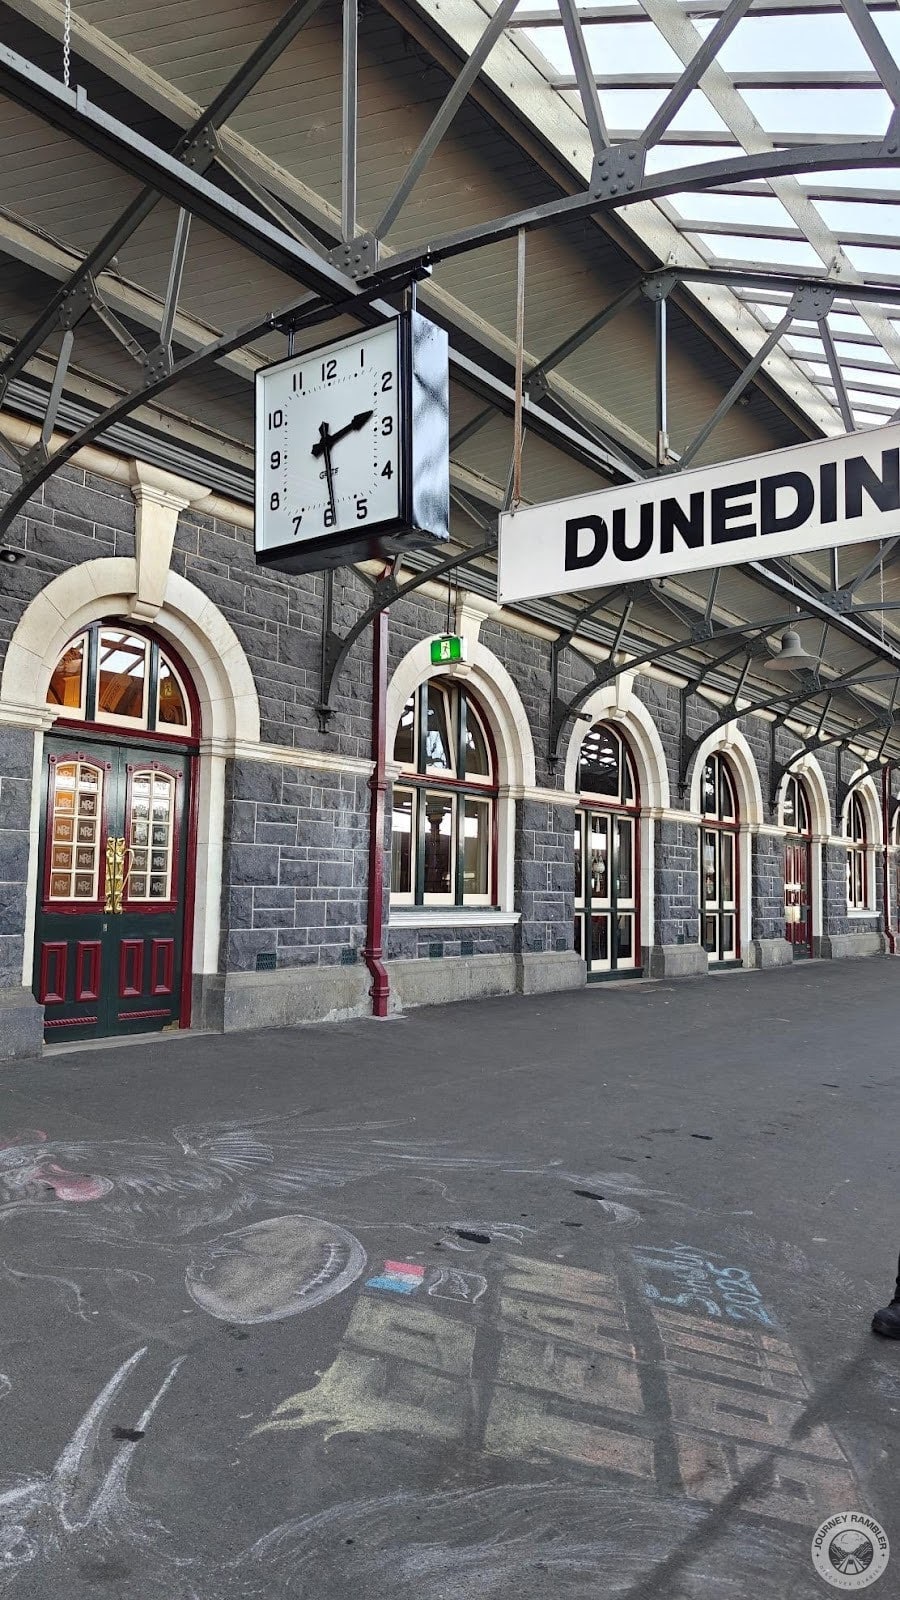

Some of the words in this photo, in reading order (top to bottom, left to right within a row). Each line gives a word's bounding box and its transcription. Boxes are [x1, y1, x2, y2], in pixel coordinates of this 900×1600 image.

[360, 348, 364, 368] 1
[322, 360, 337, 381] 12
[293, 372, 303, 392] 11
[382, 372, 392, 392] 2
[268, 410, 282, 430] 10
[382, 416, 393, 436] 3
[270, 450, 280, 470] 9
[382, 460, 394, 480] 4
[270, 492, 280, 511] 8
[356, 499, 368, 519] 5
[564, 448, 900, 572] DUNEDIN
[292, 516, 303, 535] 7
[324, 508, 335, 528] 6
